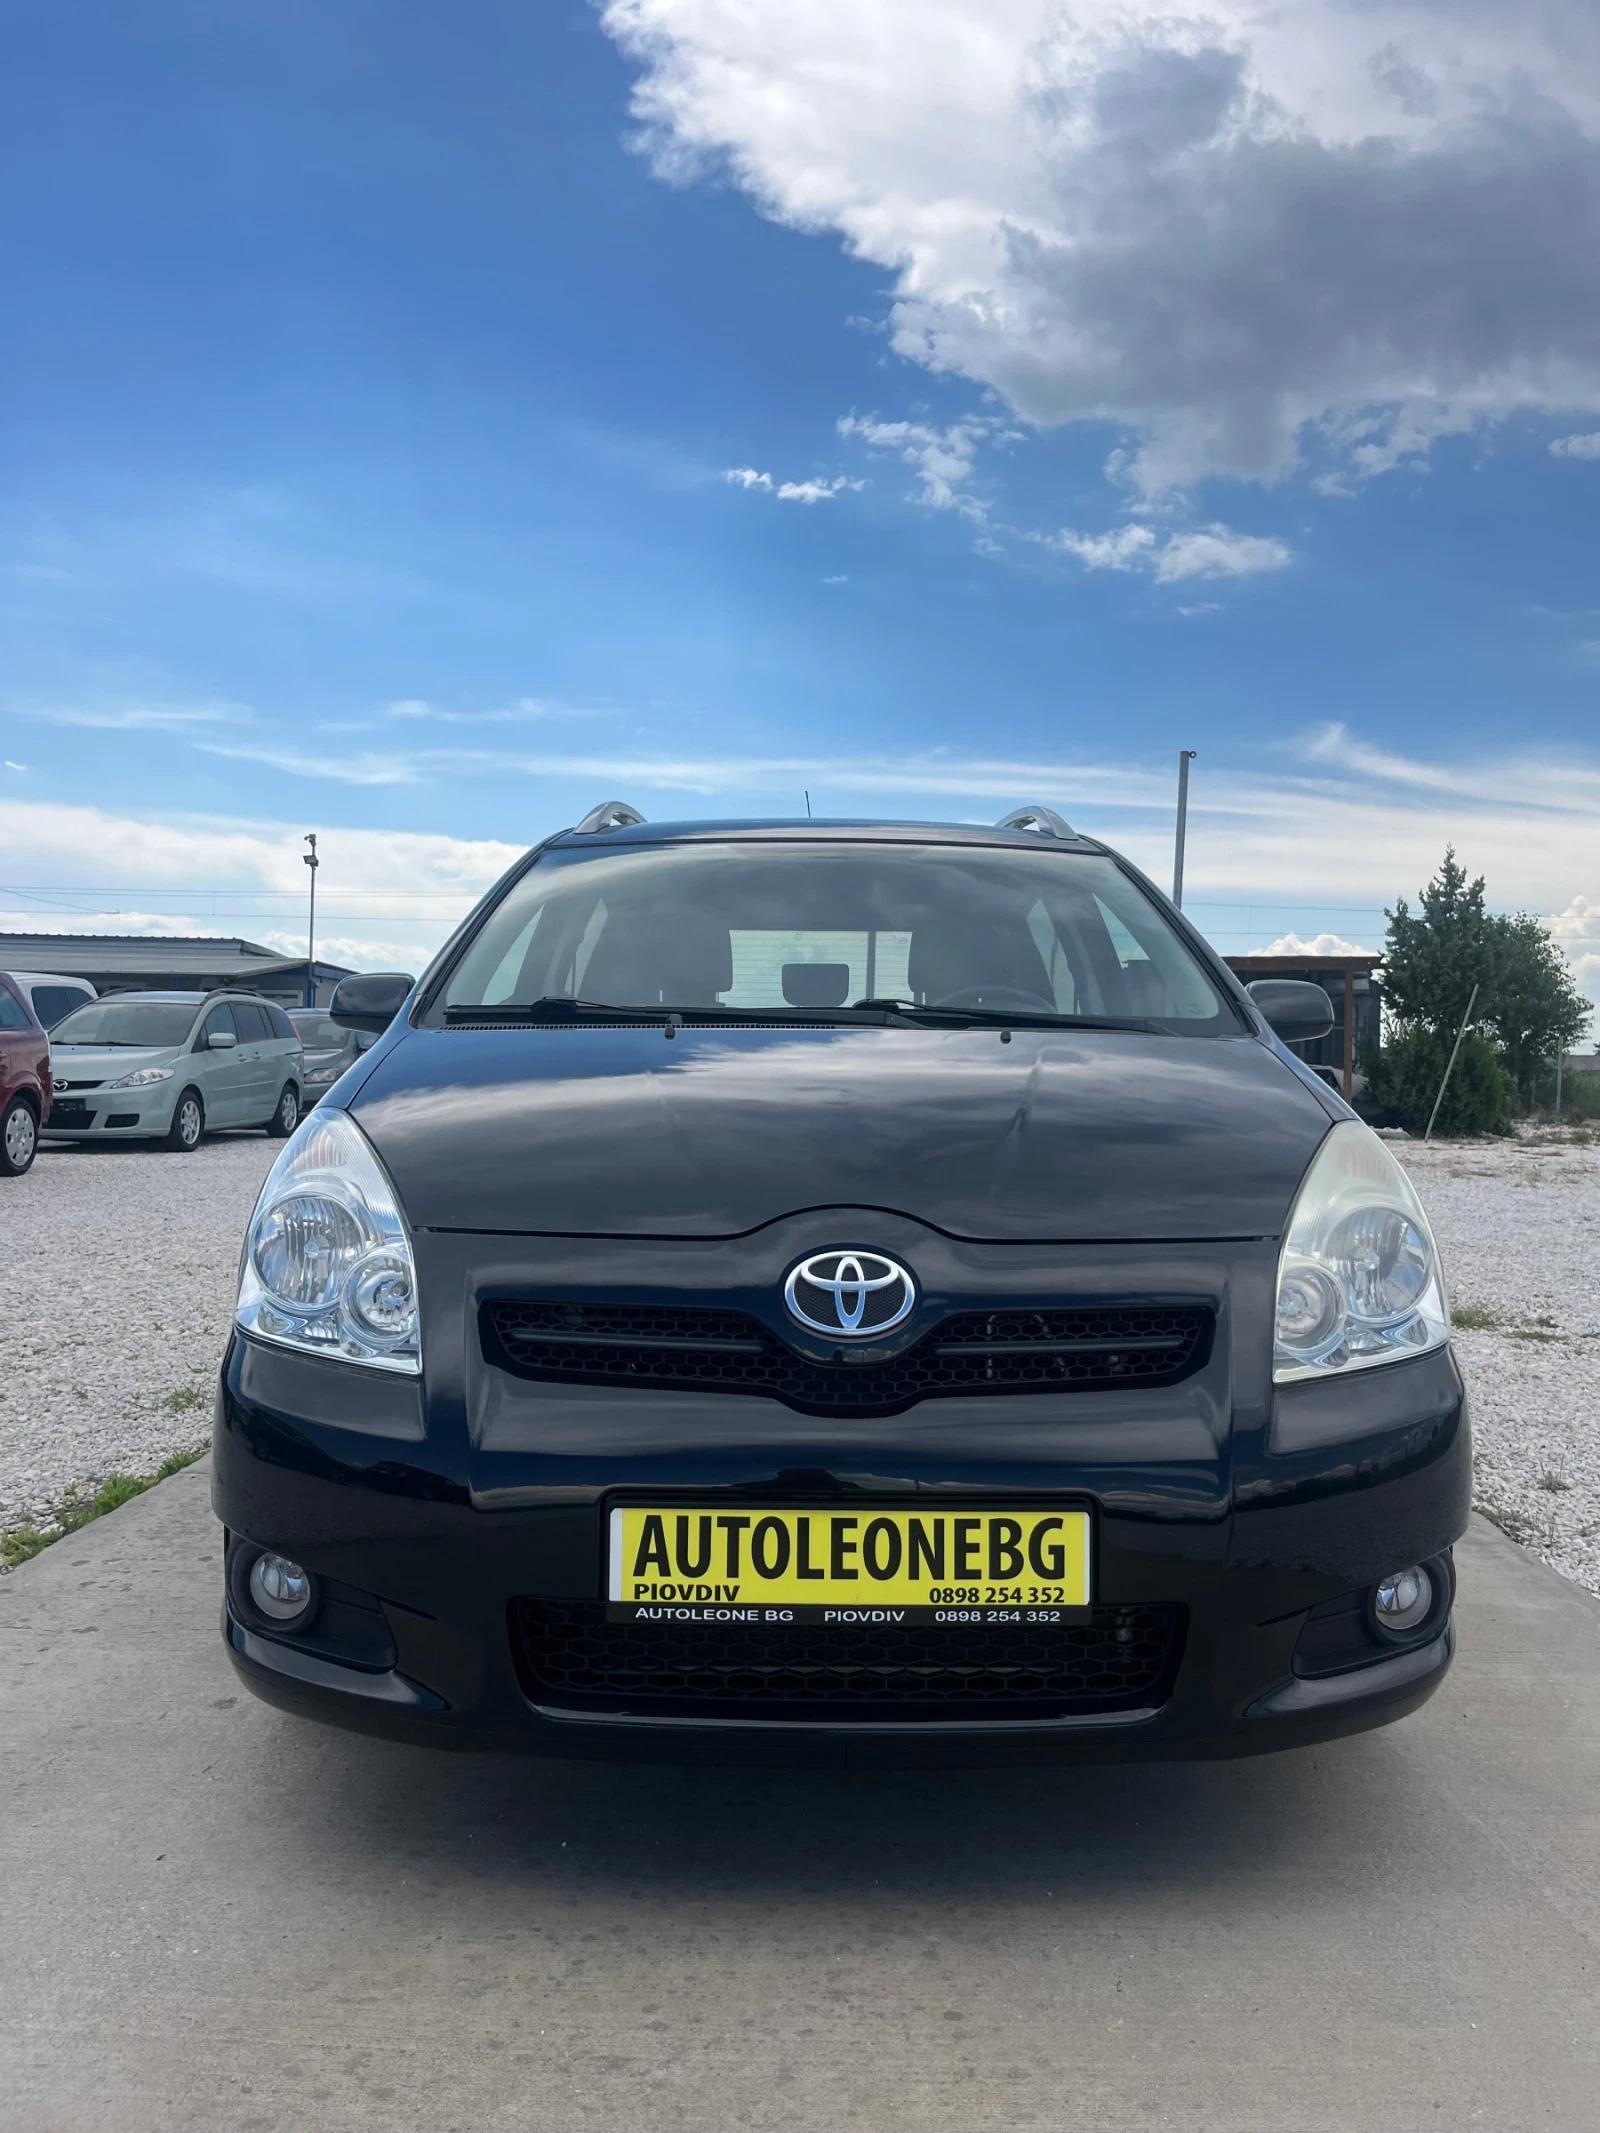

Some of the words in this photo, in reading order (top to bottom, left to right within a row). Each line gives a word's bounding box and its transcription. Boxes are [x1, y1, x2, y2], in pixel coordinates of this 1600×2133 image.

[632, 1514, 1066, 1581] AUTOLEONEBG
[929, 1587, 980, 1604] 0898
[984, 1587, 1023, 1604] 254
[1027, 1586, 1065, 1604] 352
[635, 1607, 759, 1621] AUTOLEONE
[765, 1609, 794, 1622] BG
[935, 1610, 981, 1623] 0898
[986, 1610, 1021, 1623] 254
[1026, 1610, 1061, 1623] 352
